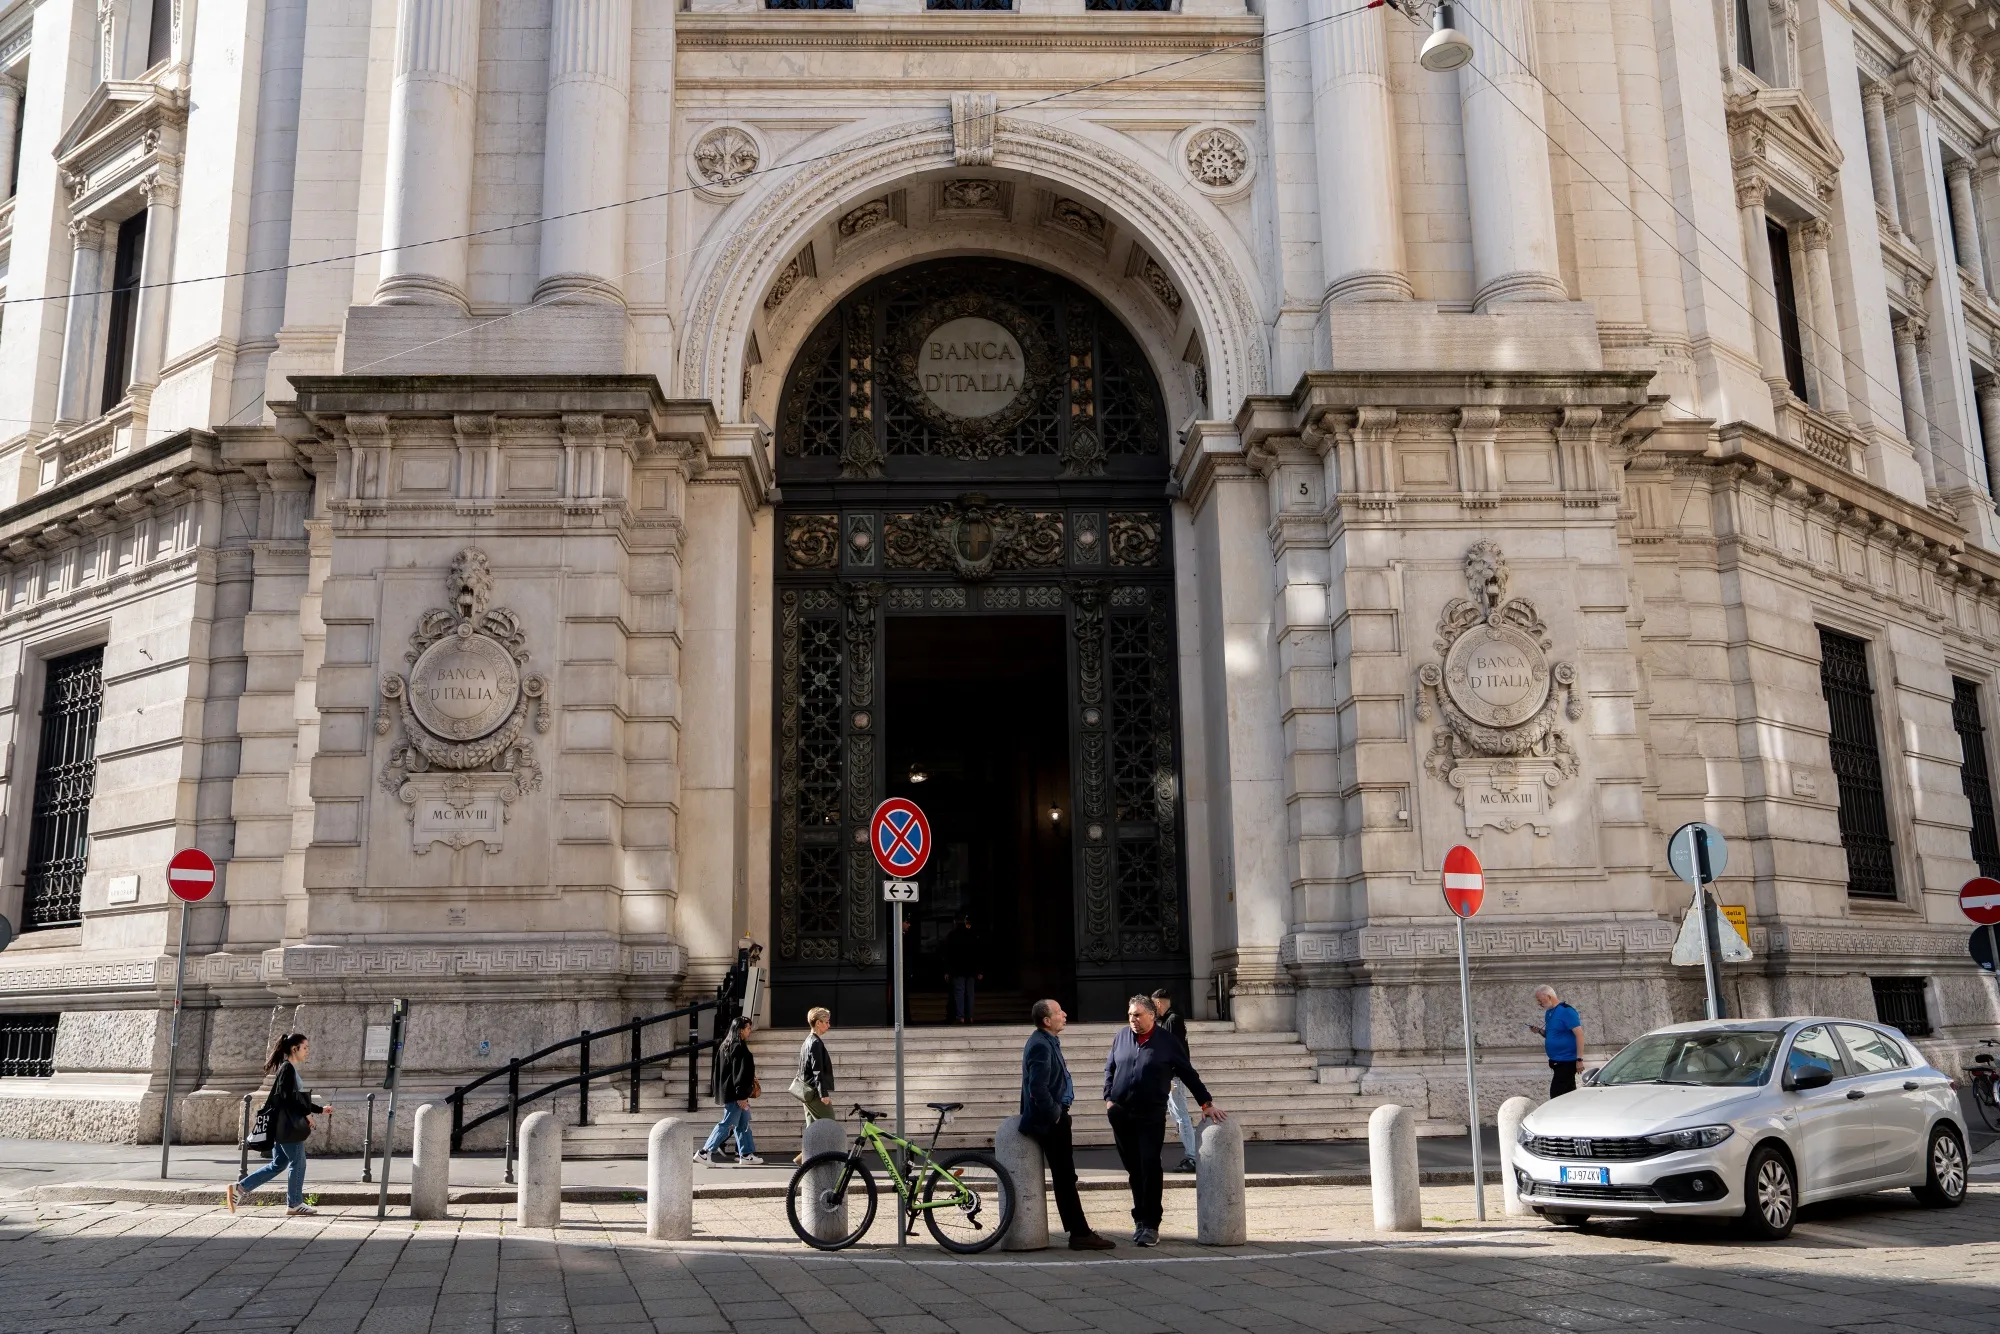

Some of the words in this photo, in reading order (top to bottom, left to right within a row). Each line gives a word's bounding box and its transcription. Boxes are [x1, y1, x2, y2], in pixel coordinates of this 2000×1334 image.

[929, 342, 1016, 360] BANCA
[925, 373, 1020, 392] D'ITALIA
[1300, 483, 1308, 495] 5
[1477, 656, 1525, 669] BANCA
[437, 668, 486, 681] BANCA
[431, 687, 493, 701] D'ITALIA
[1480, 793, 1532, 804] MCMXIII
[432, 810, 488, 820] MCMVIII
[1573, 1139, 1593, 1156] FIAT
